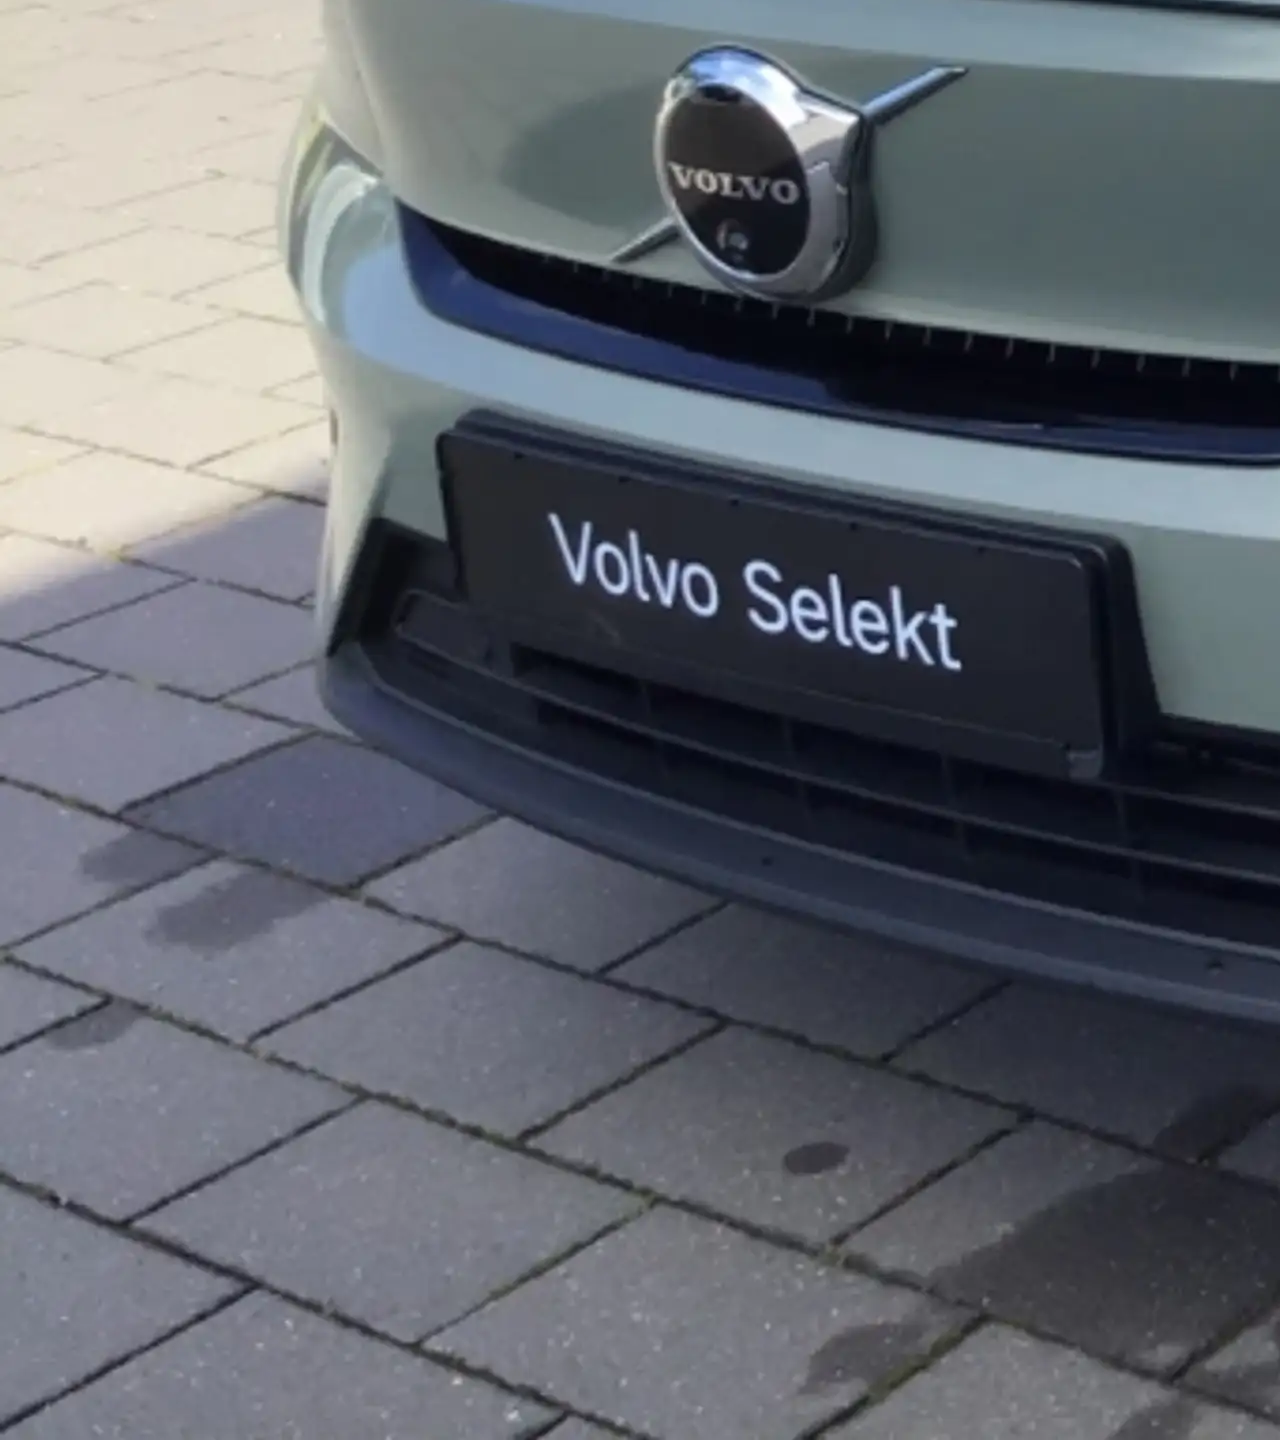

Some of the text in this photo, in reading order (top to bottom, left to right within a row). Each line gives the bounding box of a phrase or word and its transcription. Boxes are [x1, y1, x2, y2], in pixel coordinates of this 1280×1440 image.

[668, 161, 800, 205] VOLVO
[548, 512, 963, 672] Volvo Selekt
